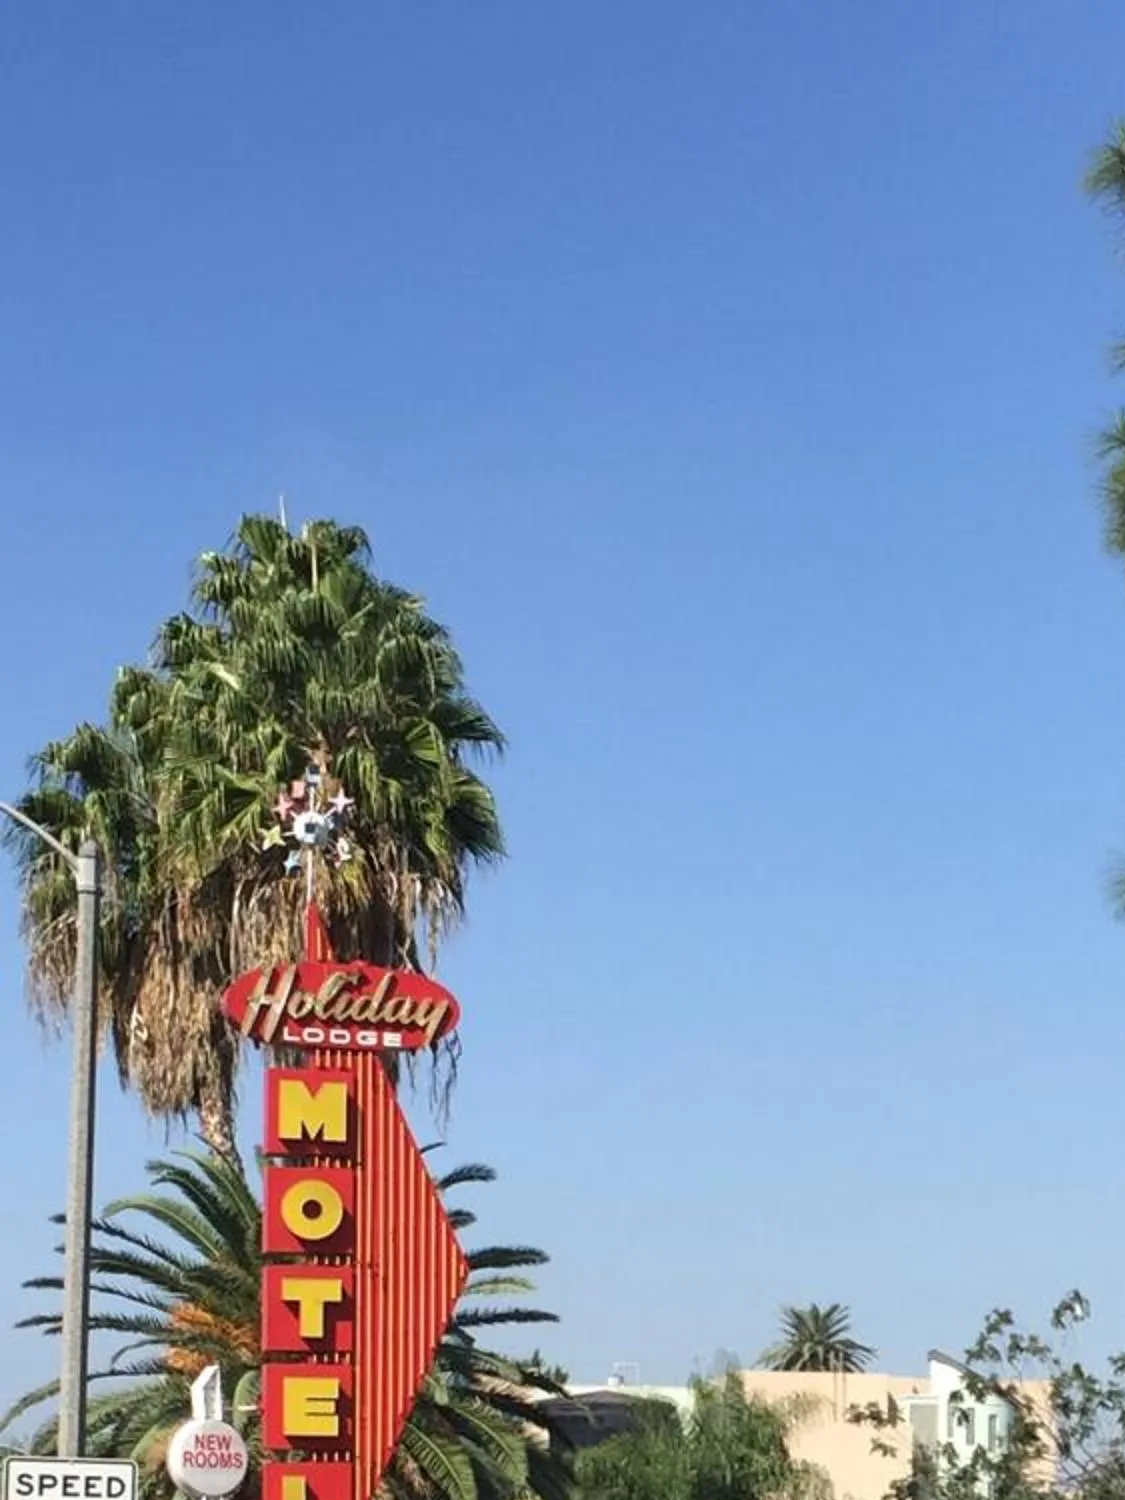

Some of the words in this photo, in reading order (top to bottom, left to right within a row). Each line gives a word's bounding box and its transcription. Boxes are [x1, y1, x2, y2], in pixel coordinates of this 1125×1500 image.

[240, 963, 449, 1044] Holiday
[283, 1026, 402, 1047] LODGE
[194, 1434, 232, 1450] NEW
[182, 1452, 243, 1469] ROOMS
[16, 1474, 126, 1499] SPEED
